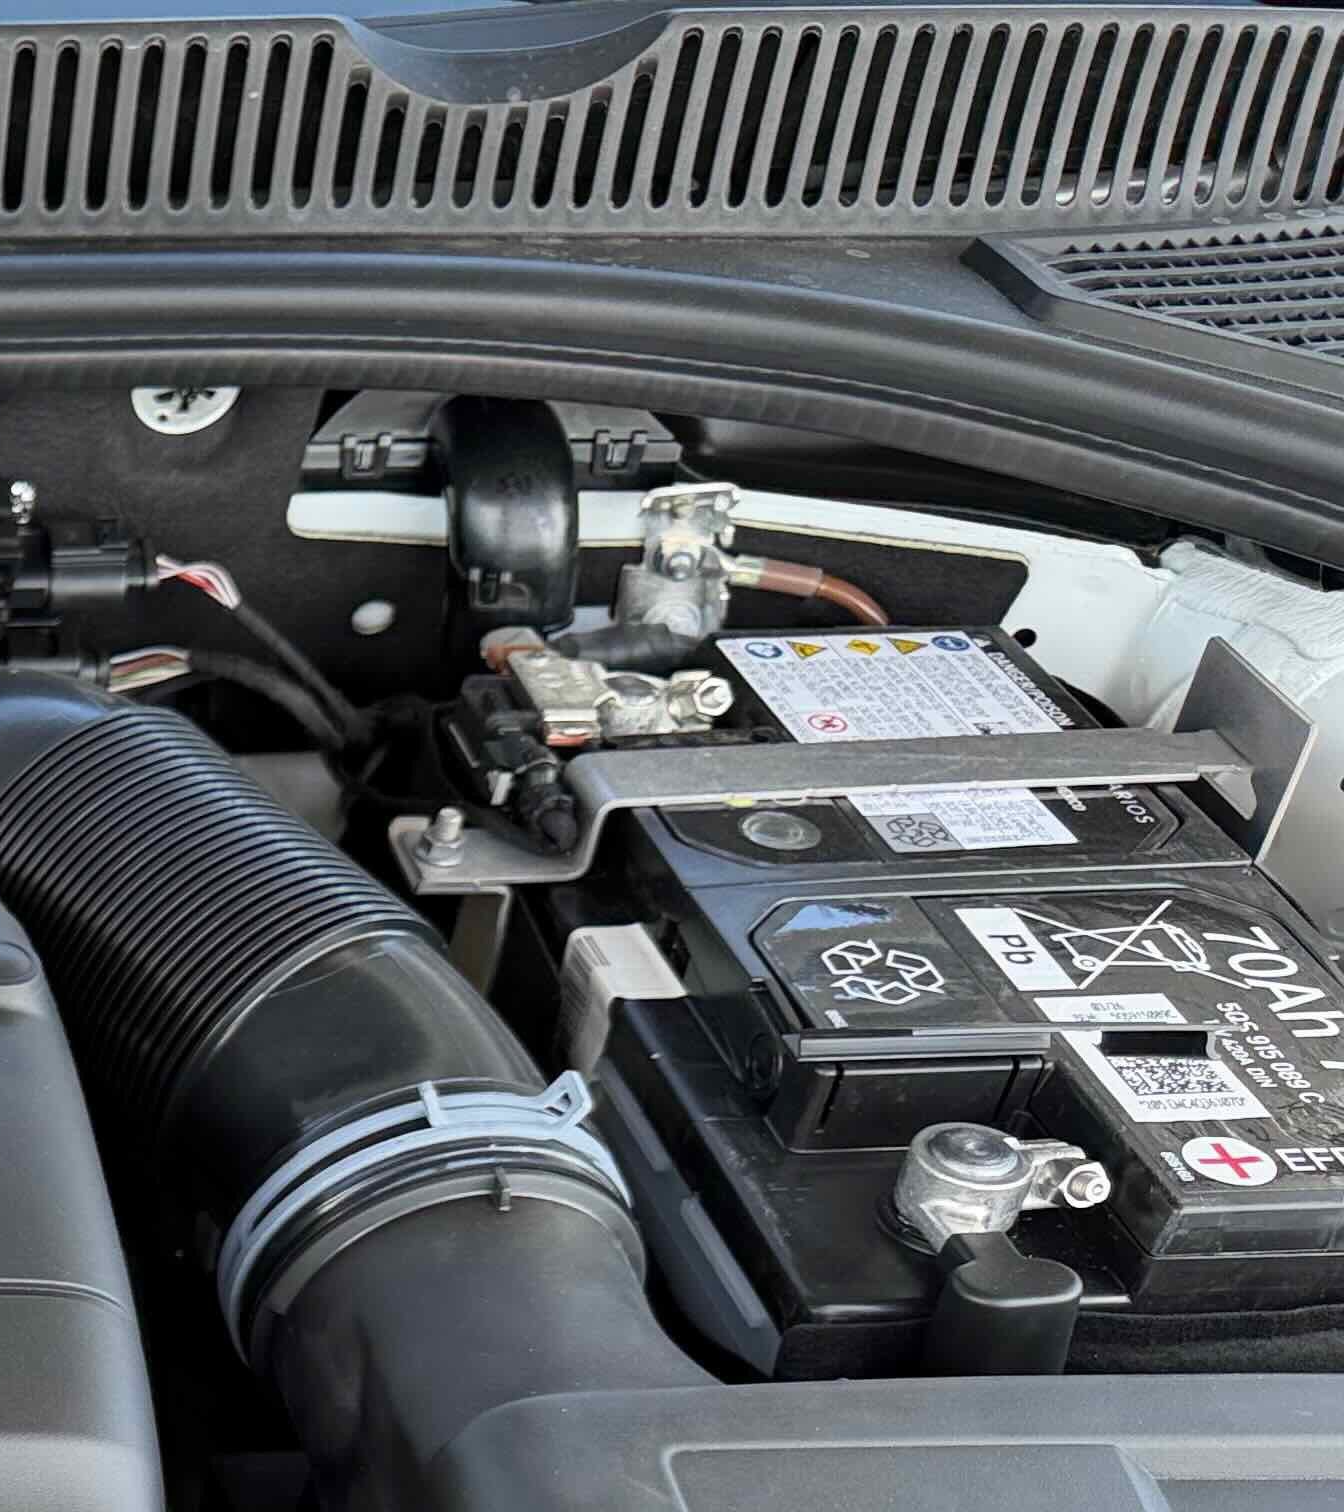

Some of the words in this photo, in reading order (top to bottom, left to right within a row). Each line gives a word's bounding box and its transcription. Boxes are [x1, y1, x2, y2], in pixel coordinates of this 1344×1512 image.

[986, 933, 1034, 965] Pb
[1201, 926, 1344, 1038] 70Ah
[1245, 1035, 1285, 1062] 915
[1270, 1062, 1312, 1090] 089
[1298, 1091, 1325, 1105] C
[1246, 1066, 1278, 1088] DIN
